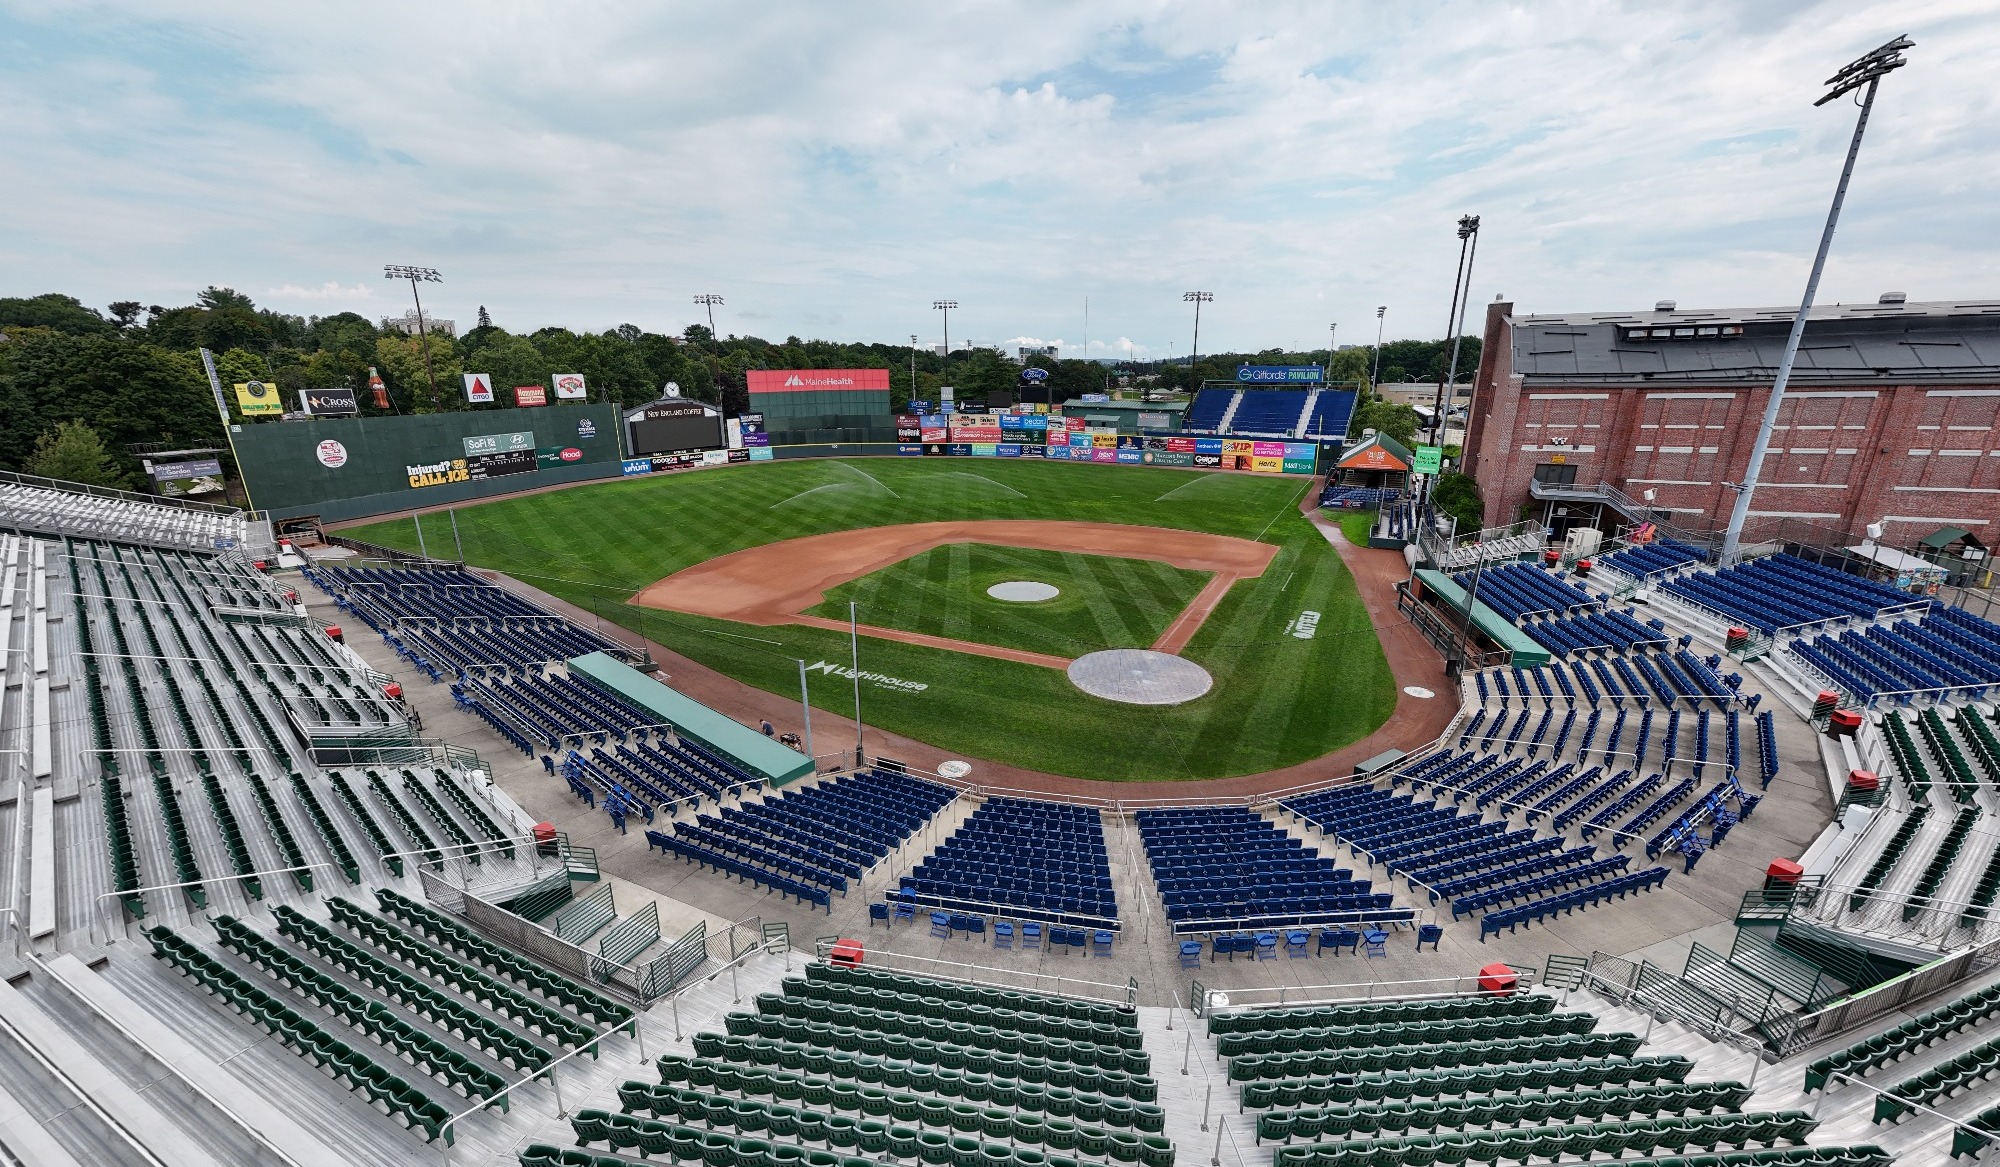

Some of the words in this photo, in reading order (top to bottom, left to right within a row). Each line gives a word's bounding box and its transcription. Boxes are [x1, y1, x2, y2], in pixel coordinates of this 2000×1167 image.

[1288, 371, 1319, 380] PAVILION
[805, 378, 853, 386] MaineHealth
[647, 410, 659, 418] NEW
[660, 409, 683, 417] ENGLAND
[683, 408, 702, 416] COFFEE
[898, 428, 921, 437] KeyBank
[468, 439, 487, 449] SoFi
[1233, 442, 1252, 451] VIP
[562, 450, 581, 459] Hood
[1194, 455, 1220, 464] Geiger
[1258, 460, 1277, 468] Hertz
[155, 464, 184, 472] Shaheen
[166, 468, 191, 476] Gordon
[406, 461, 451, 477] Injured?
[624, 462, 649, 473] unum
[833, 666, 928, 691] Lighthouse
